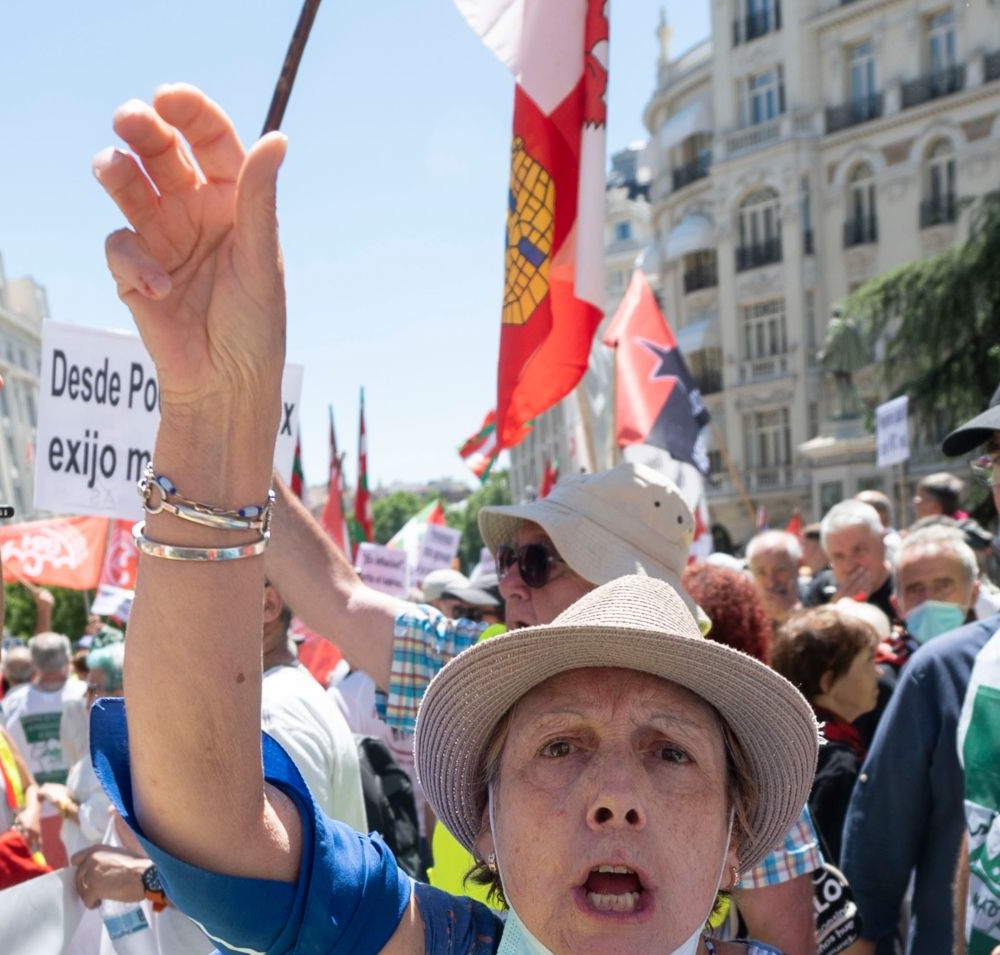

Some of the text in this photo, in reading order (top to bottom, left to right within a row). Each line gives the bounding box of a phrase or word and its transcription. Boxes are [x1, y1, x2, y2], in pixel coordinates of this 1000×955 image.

[51, 349, 121, 407] Desde
[127, 361, 162, 424] Po
[48, 429, 117, 488] exijo
